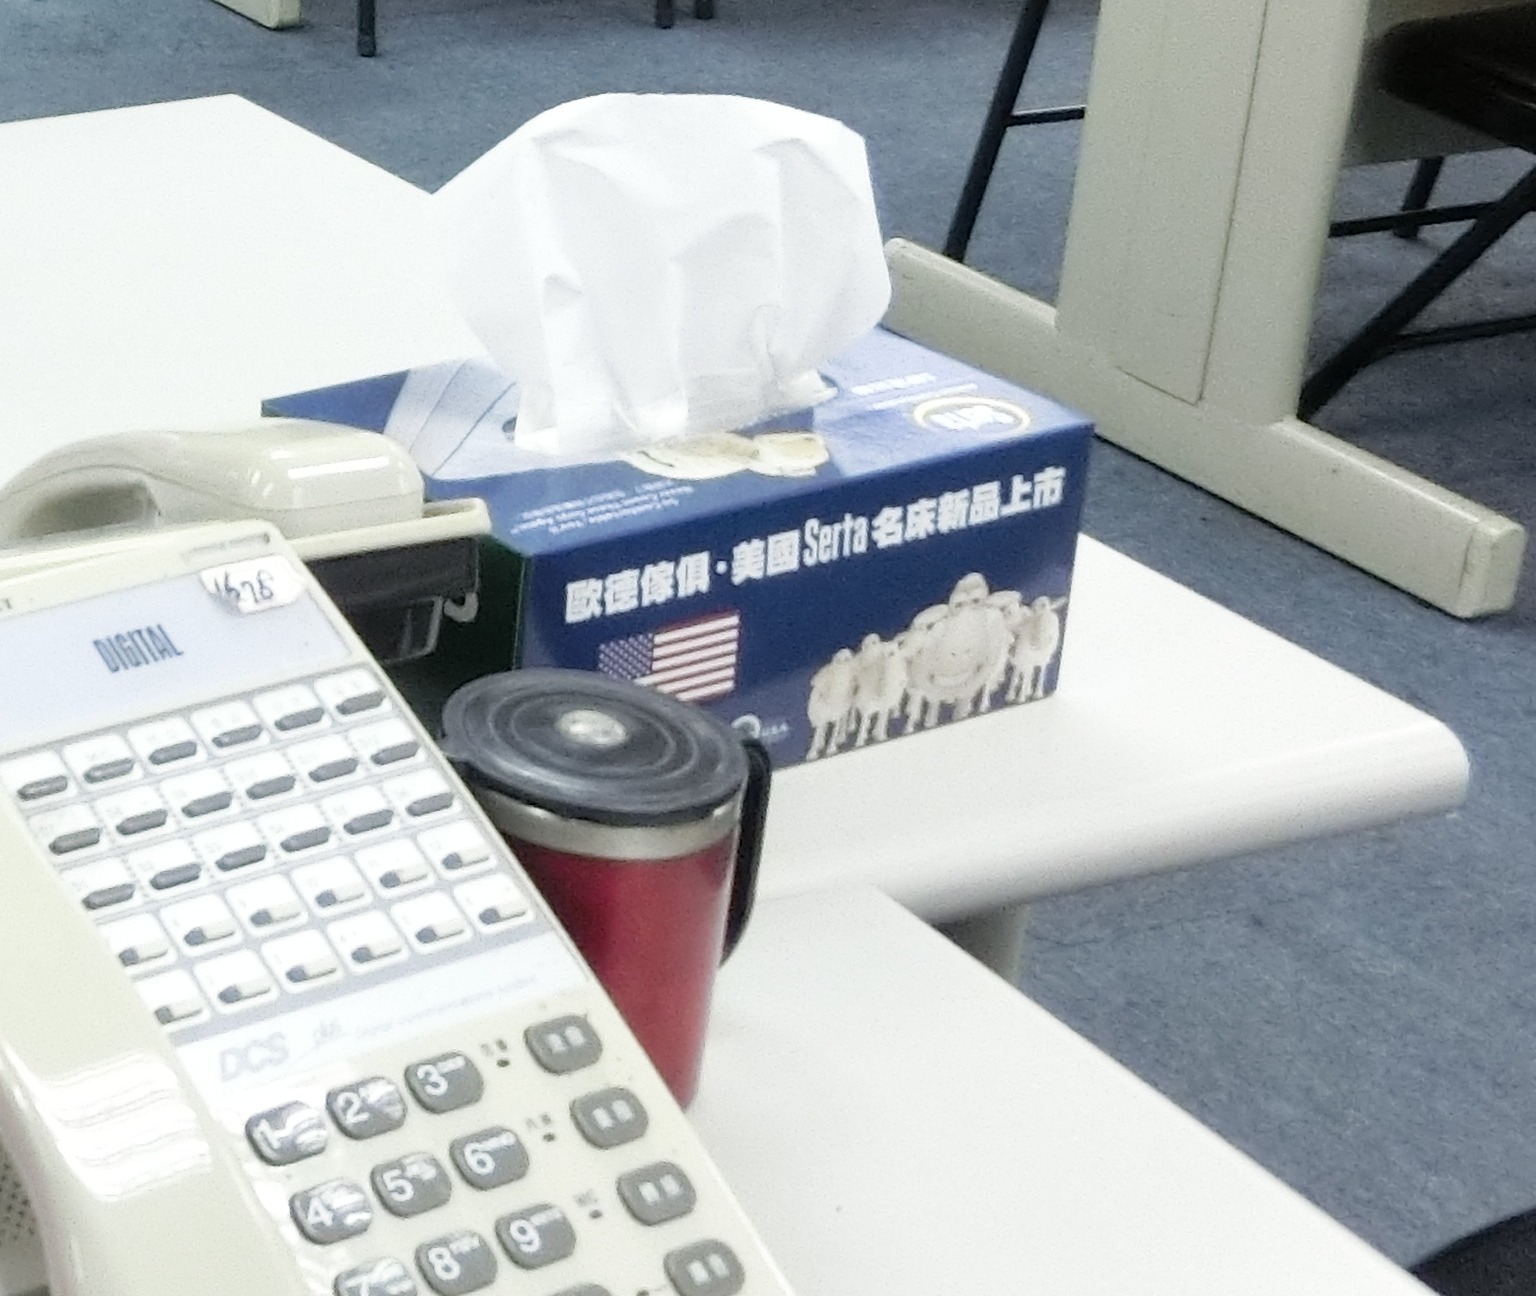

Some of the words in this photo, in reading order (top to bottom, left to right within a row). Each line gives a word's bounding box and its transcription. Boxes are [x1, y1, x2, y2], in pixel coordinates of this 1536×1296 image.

[804, 515, 869, 569] Serta
[93, 624, 184, 674] DIGITAL
[219, 1031, 289, 1082] DCS
[416, 1062, 448, 1097] 3
[336, 1091, 370, 1125] 2
[463, 1141, 496, 1176] 6
[382, 1171, 416, 1203] 5
[305, 1196, 334, 1228] 4
[509, 1217, 542, 1253] 9
[428, 1247, 462, 1283] 8
